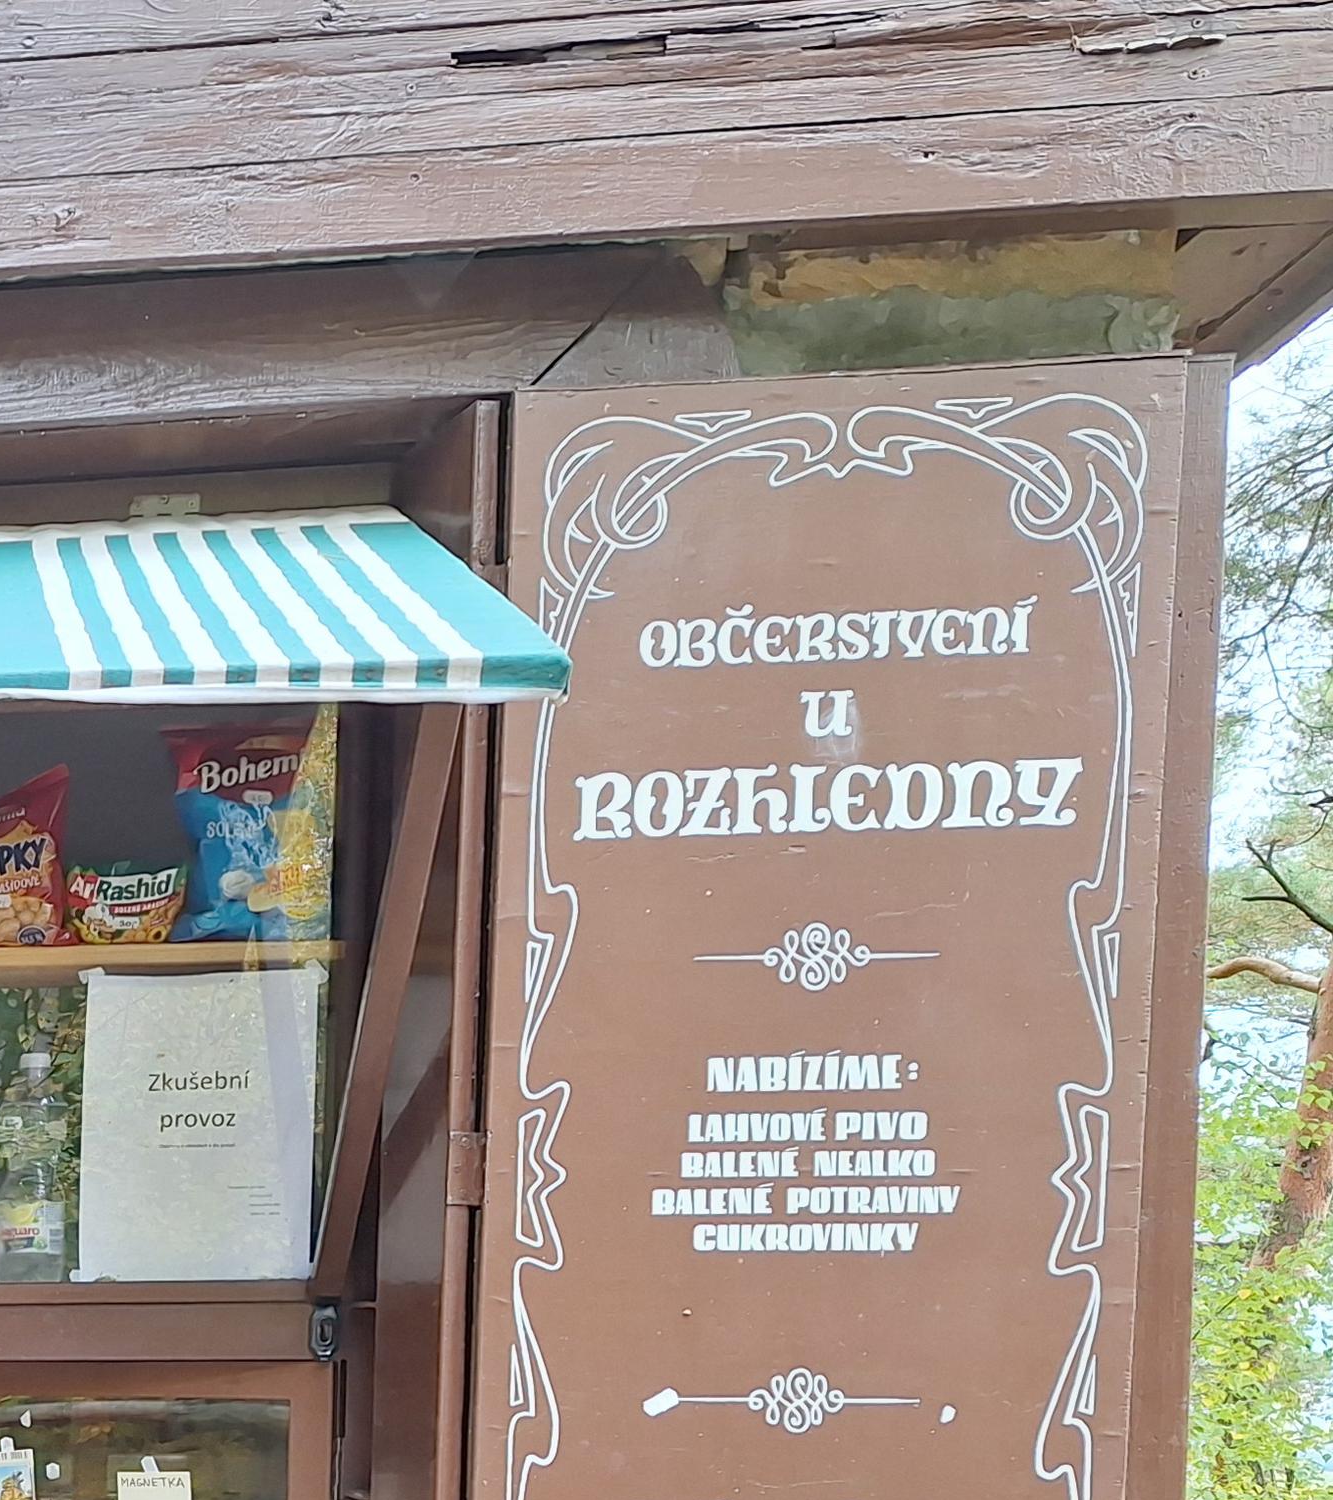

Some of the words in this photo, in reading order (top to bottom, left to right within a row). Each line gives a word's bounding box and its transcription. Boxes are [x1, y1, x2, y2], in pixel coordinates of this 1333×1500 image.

[638, 594, 1039, 669] OBČERSTVENÍ
[572, 755, 1084, 843] ROZHLEDNY
[148, 1070, 251, 1092] Zkušební
[160, 1112, 236, 1132] provoz
[687, 1107, 828, 1143] LAHVOVÉ
[834, 1110, 929, 1142] PIVO
[680, 1146, 800, 1179] BALENÉ
[813, 1149, 936, 1177] NEALKO
[651, 1182, 775, 1216] BALENÉ
[786, 1185, 961, 1215] POTRAVINY
[693, 1222, 919, 1252] CUKROVINKY
[120, 1477, 185, 1488] MAGNETKA
